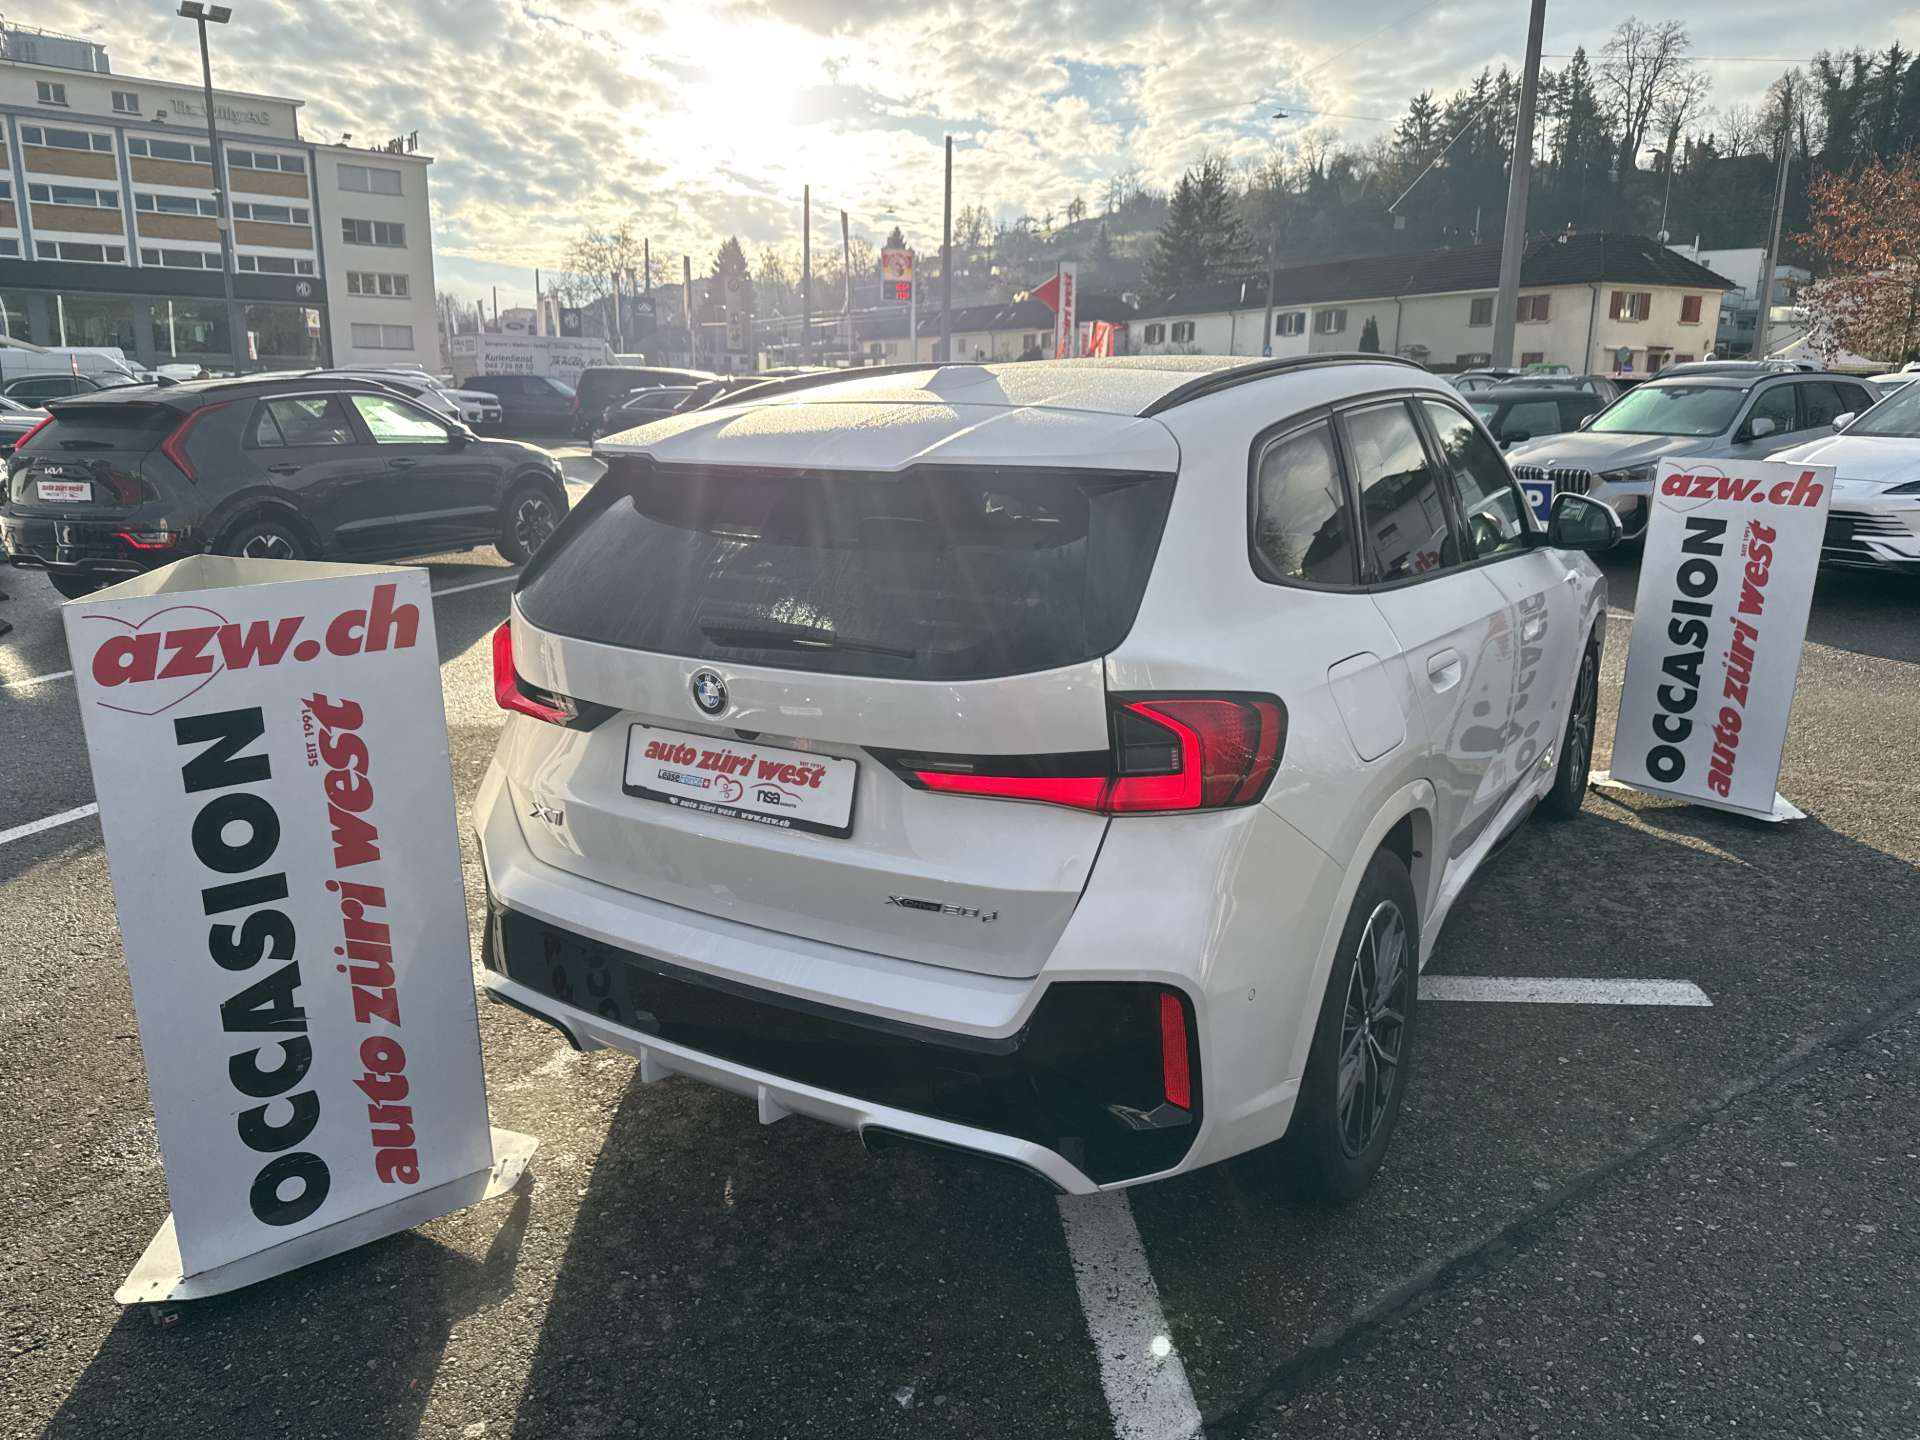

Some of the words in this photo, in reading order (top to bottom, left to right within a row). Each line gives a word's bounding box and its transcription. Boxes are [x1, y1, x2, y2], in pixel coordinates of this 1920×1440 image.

[1526, 489, 1544, 507] P
[1661, 471, 1824, 508] azw.ch
[1738, 519, 1777, 615] west
[92, 583, 420, 688] azw.ch
[1645, 516, 1728, 783] OCCASION
[1721, 616, 1759, 710] züri
[301, 708, 314, 738] 1991
[305, 742, 319, 768] SEIT
[644, 740, 697, 767] auto
[696, 749, 757, 776] züri
[757, 759, 827, 789] west
[1708, 705, 1743, 798] auto
[300, 692, 381, 869] west
[529, 801, 564, 826] X1
[741, 812, 791, 828] www.azw.ch
[173, 706, 331, 1227] OCCASION
[325, 879, 402, 1029] züri
[352, 1035, 420, 1185] auto
